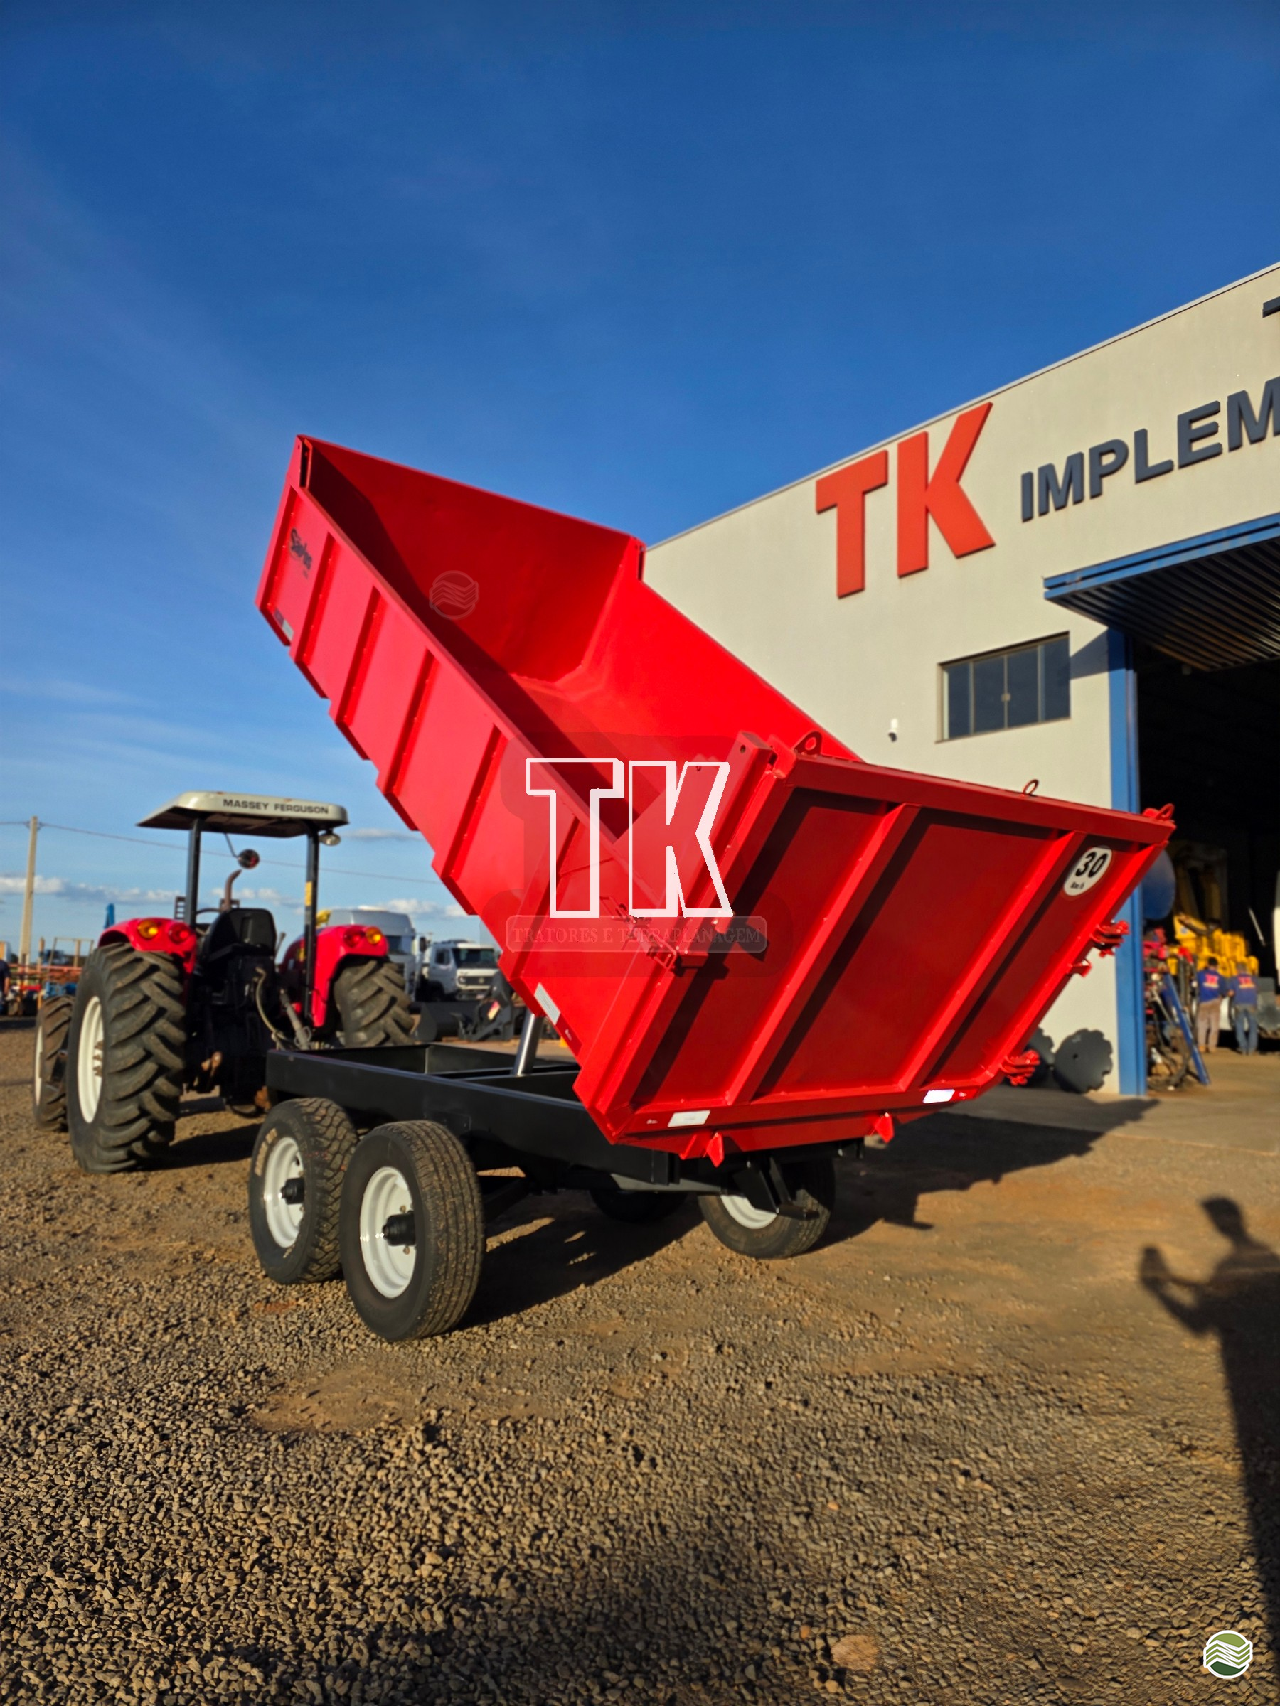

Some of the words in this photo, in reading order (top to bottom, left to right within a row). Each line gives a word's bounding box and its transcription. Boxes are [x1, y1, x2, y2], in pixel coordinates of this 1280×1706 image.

[815, 402, 996, 599] TK
[223, 799, 269, 811] MASSEY
[273, 803, 329, 814] FERGUSON
[1075, 851, 1109, 878] 30
